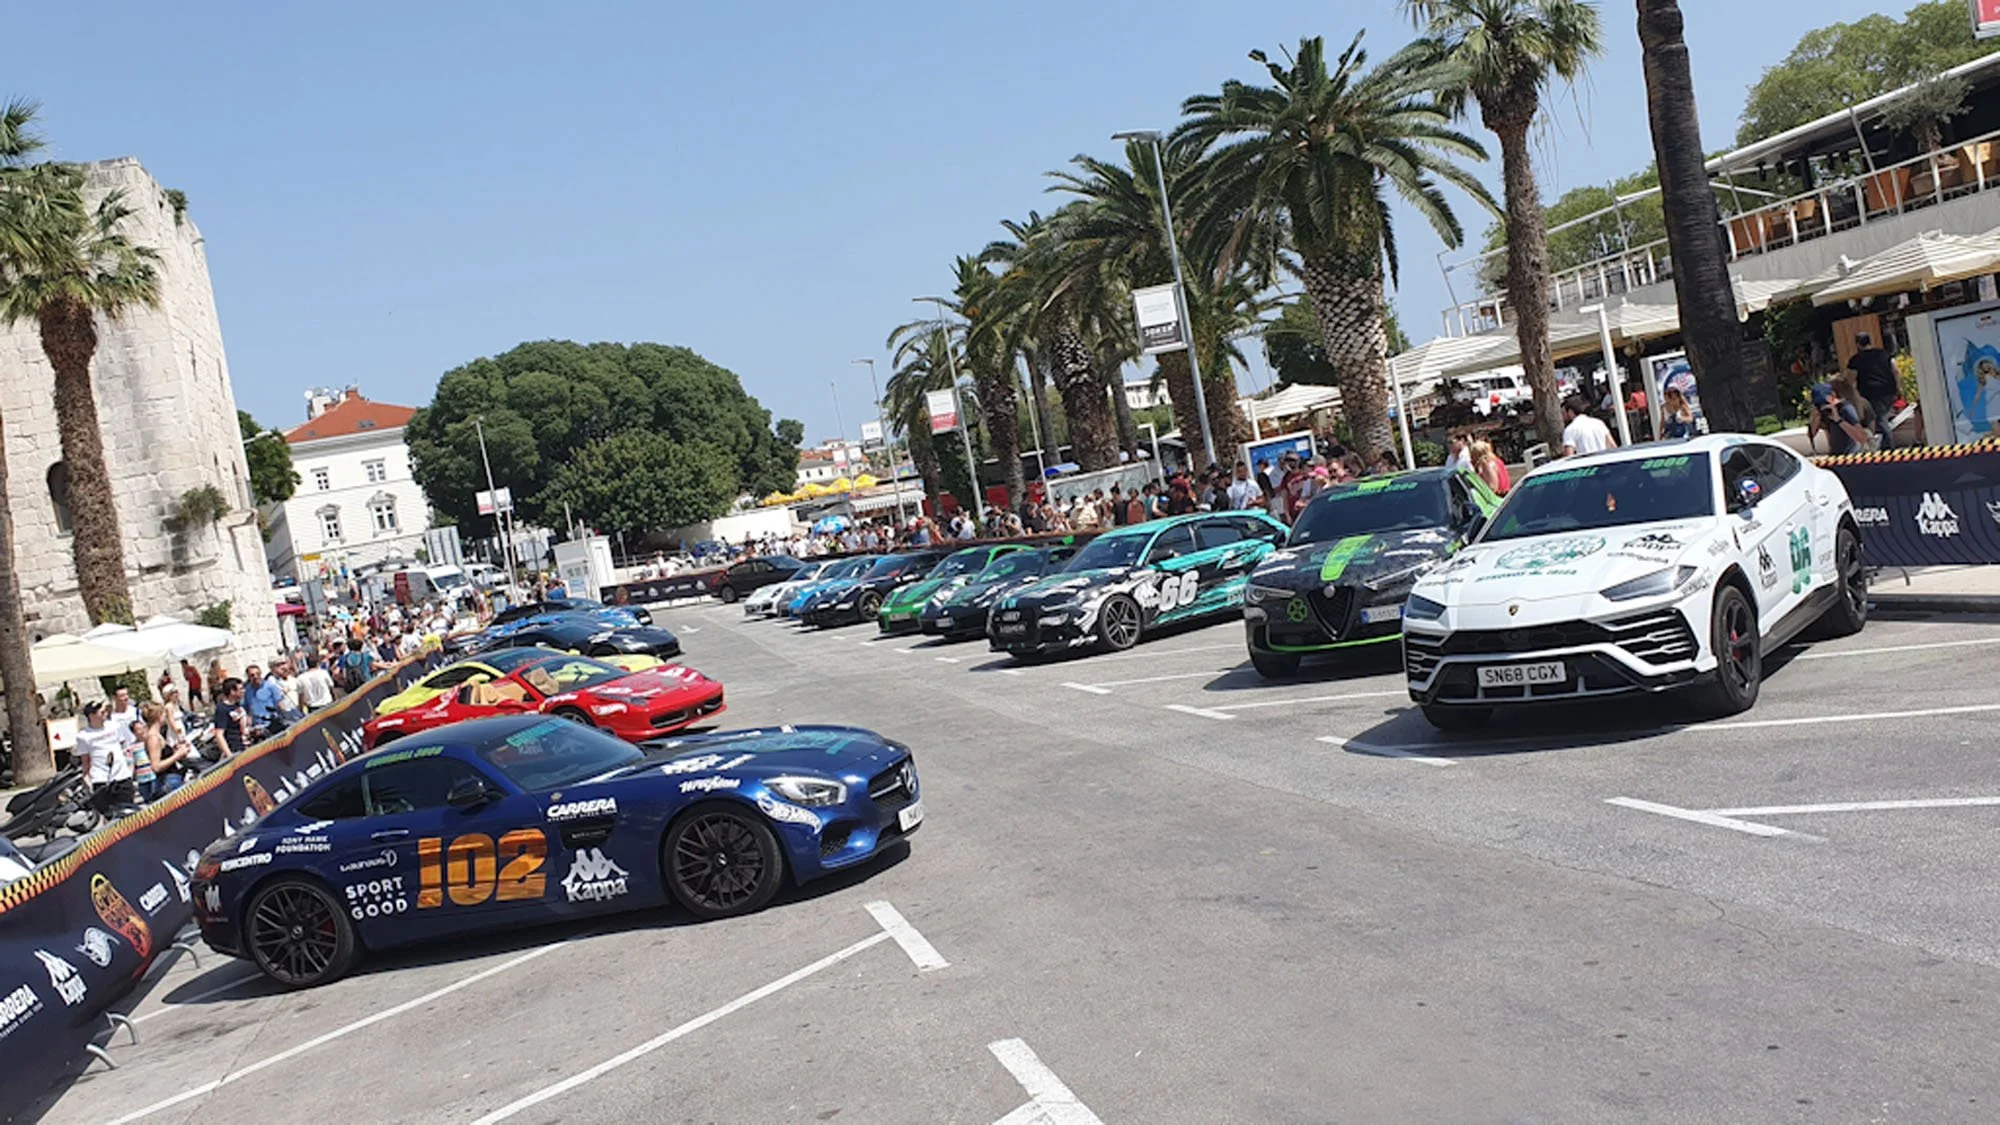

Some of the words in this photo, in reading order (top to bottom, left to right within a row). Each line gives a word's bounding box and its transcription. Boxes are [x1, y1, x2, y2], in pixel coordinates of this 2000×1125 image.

[1640, 456, 1691, 471] 3000
[1918, 519, 1960, 538] Kappa
[1158, 569, 1200, 612] 66
[1484, 667, 1524, 684] SN68
[1527, 664, 1559, 680] CGX
[546, 796, 617, 818] CARRERA
[417, 828, 548, 909] 102
[345, 876, 403, 900] SPORT
[565, 877, 629, 903] Kappa
[351, 898, 408, 921] GOOD
